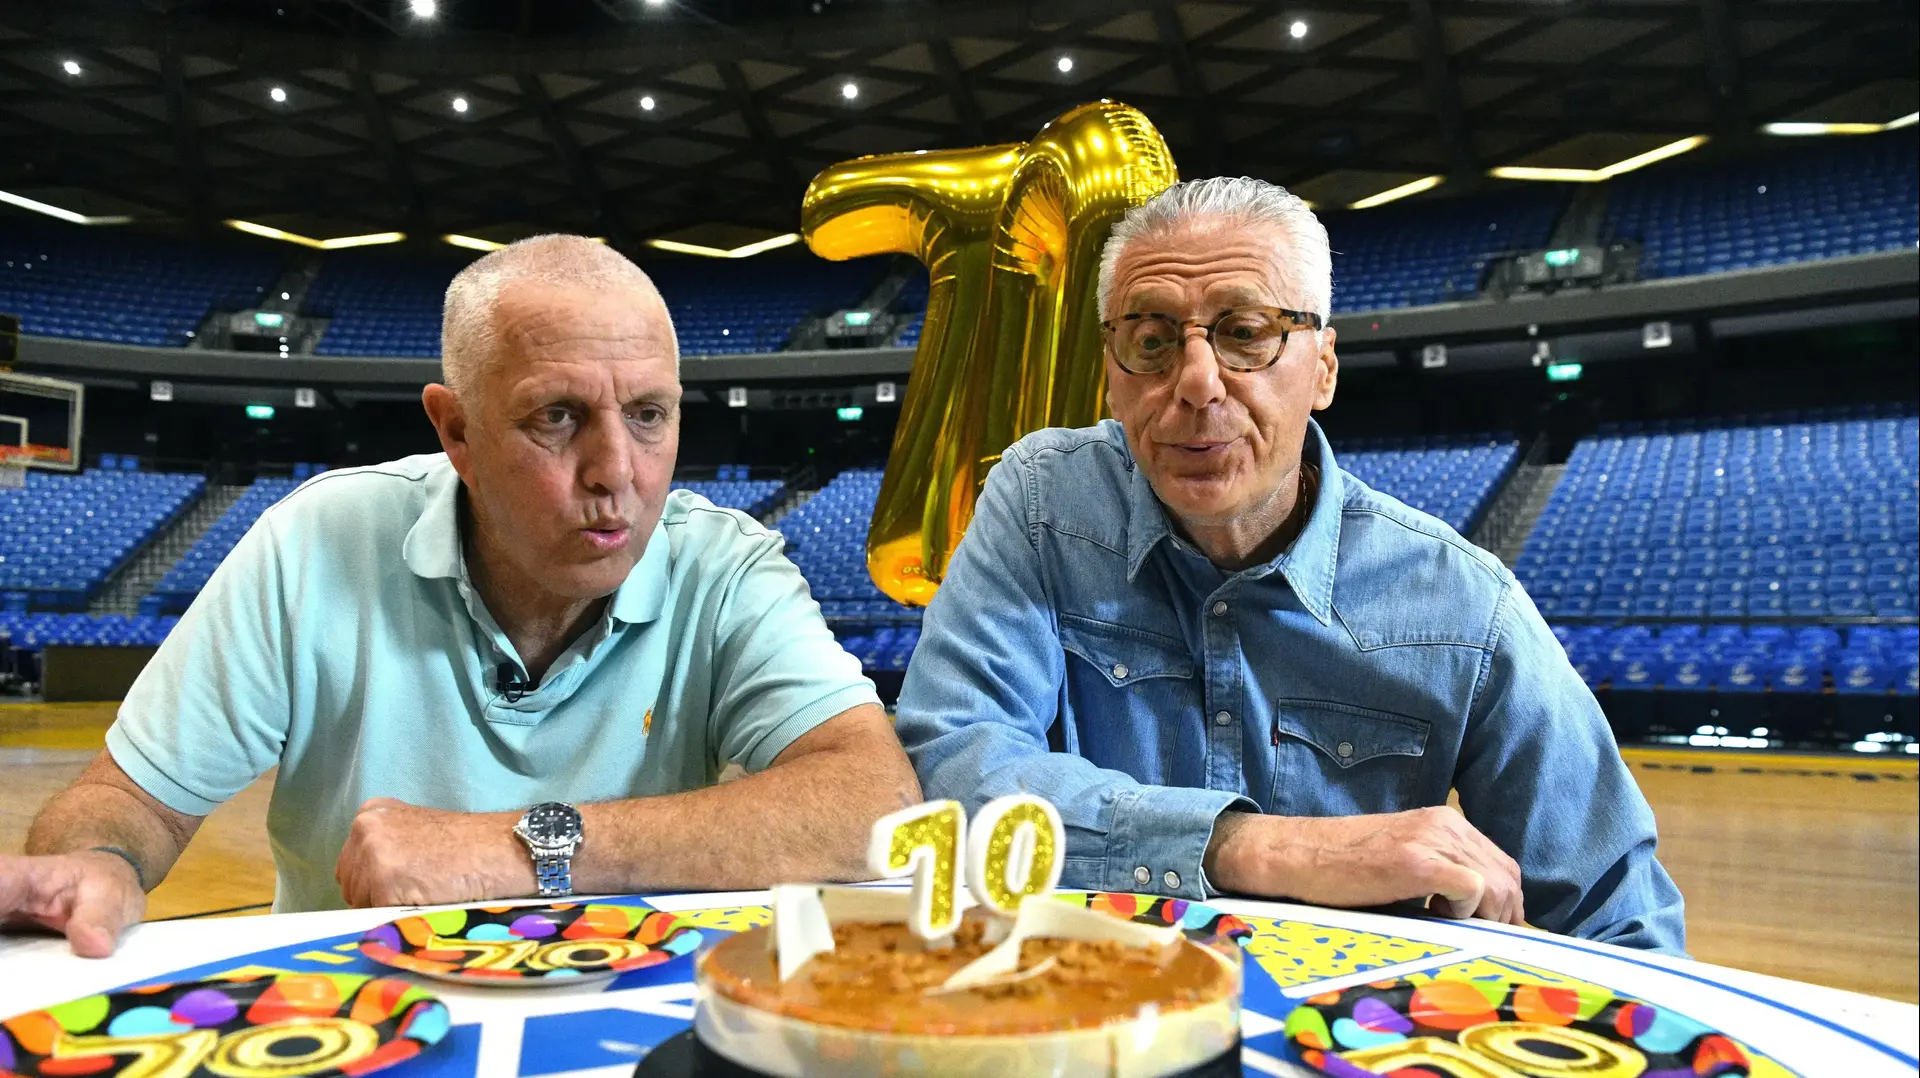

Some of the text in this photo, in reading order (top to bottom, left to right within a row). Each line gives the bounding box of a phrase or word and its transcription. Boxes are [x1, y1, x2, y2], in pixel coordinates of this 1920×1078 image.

[868, 792, 1067, 940] 70
[425, 934, 651, 970] 70
[52, 1016, 379, 1078] 70
[1333, 1020, 1648, 1078] 70
